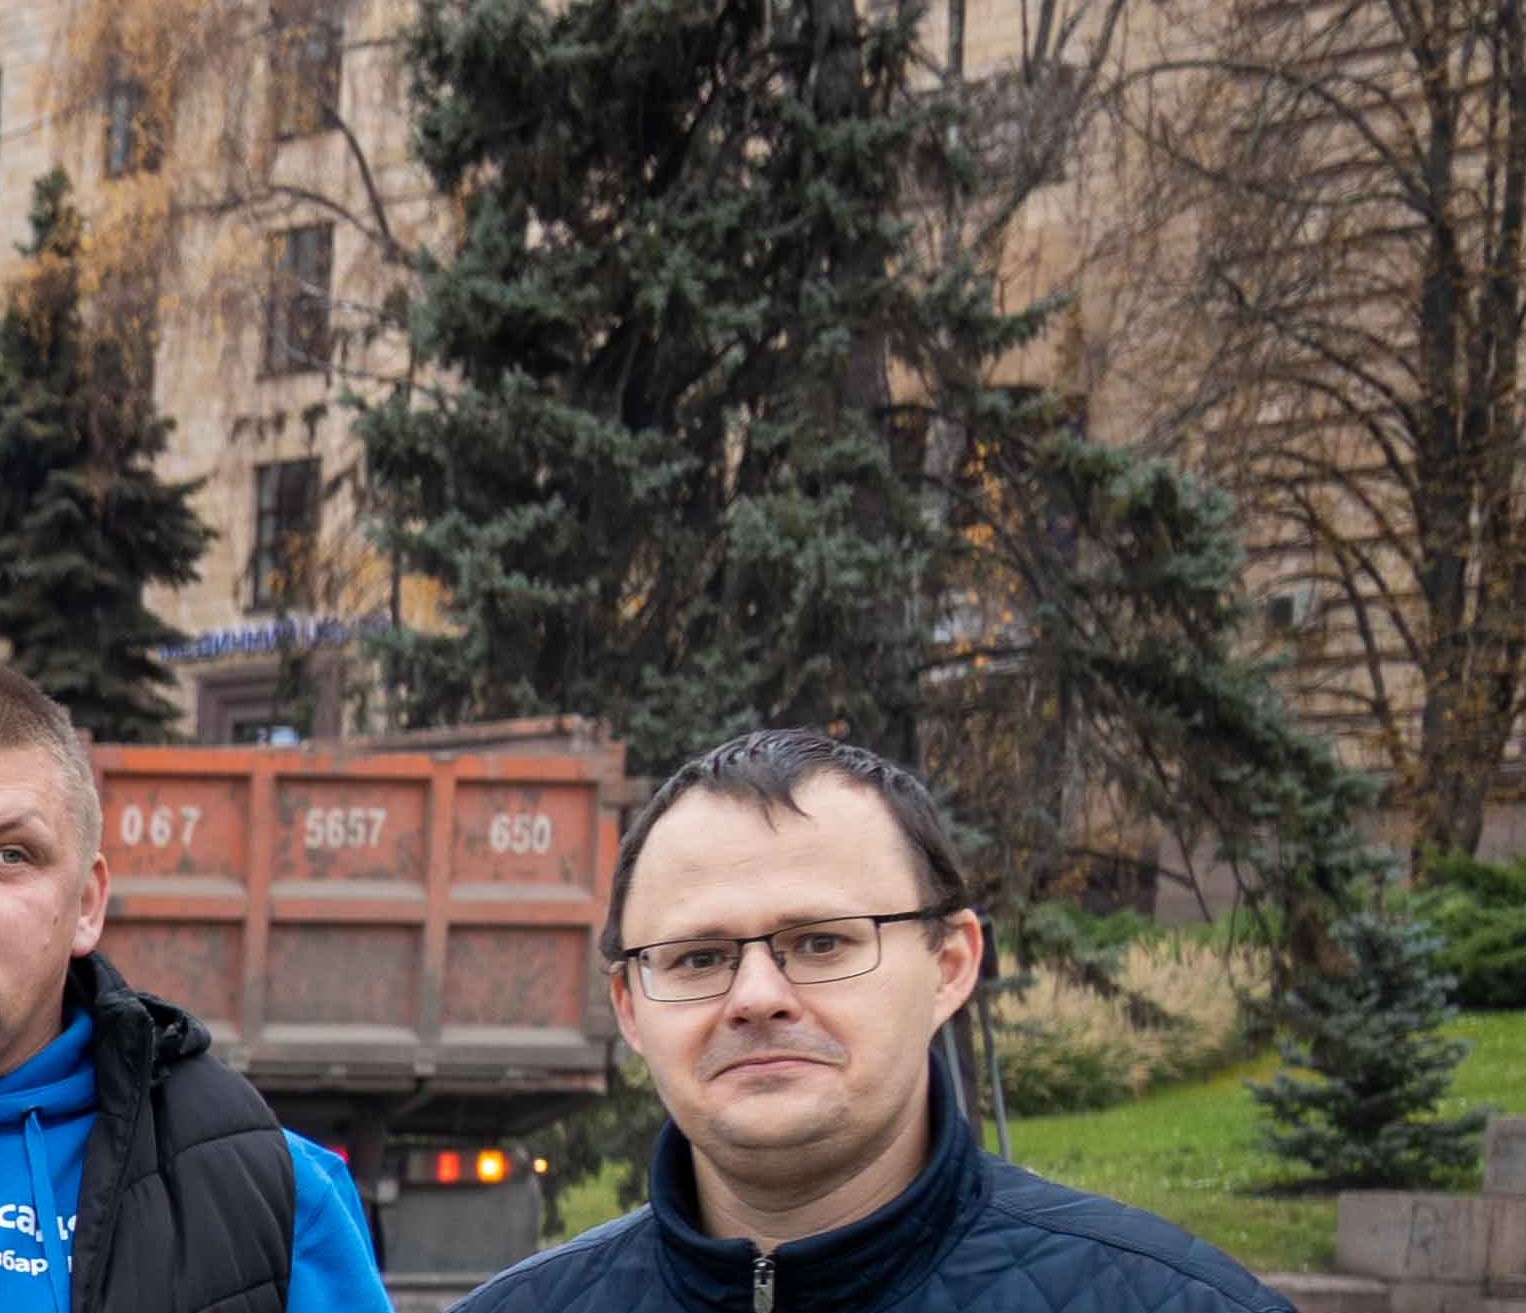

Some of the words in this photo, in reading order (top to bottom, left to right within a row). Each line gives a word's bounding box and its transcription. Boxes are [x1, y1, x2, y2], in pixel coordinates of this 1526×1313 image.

[121, 804, 202, 848] 067
[303, 807, 387, 849] 5657
[488, 812, 553, 855] 650
